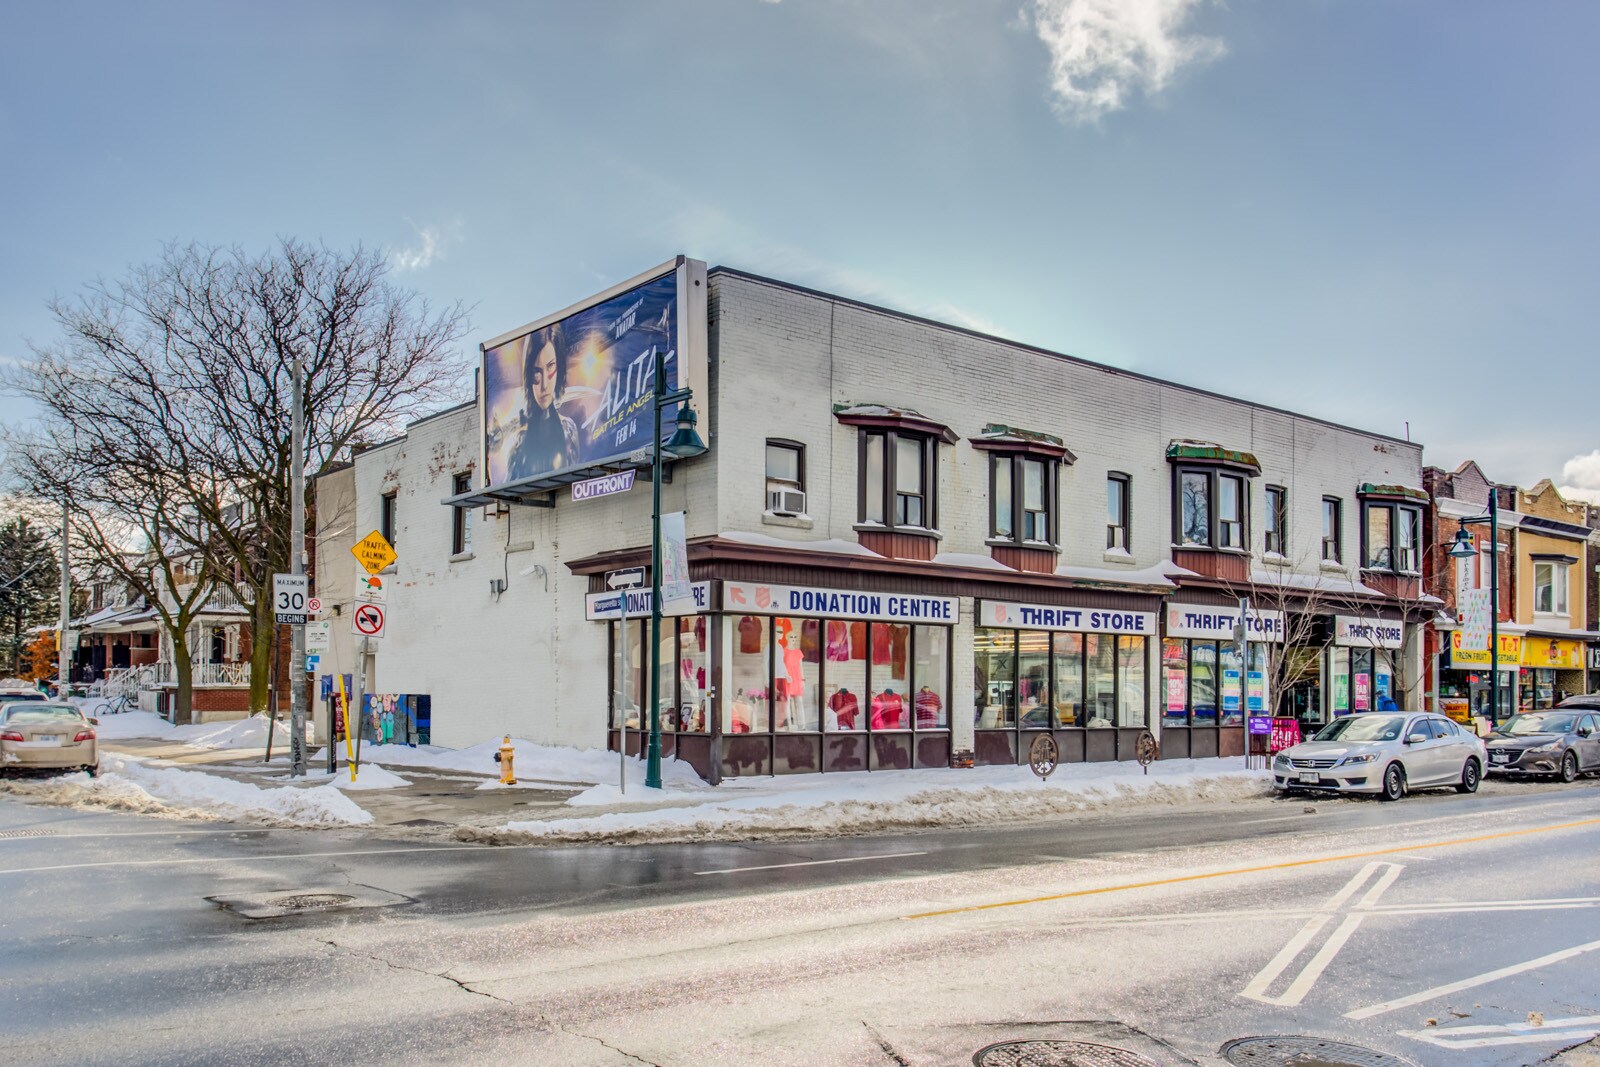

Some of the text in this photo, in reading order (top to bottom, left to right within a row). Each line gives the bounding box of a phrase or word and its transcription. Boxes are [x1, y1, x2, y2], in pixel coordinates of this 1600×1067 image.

[615, 311, 636, 340] AVATAR
[581, 345, 675, 432] ALITA
[593, 389, 655, 439] BATTLE ANGEL
[615, 424, 629, 447] FEB
[574, 473, 632, 499] OUTFRONT
[363, 540, 387, 551] TRAFFIC
[361, 550, 387, 561] CALMING
[365, 561, 380, 571] ZONE
[276, 579, 305, 587] MAXIMUM
[278, 592, 304, 610] 30
[789, 590, 951, 619] DONATION CENTRE
[277, 614, 305, 623] BEGINS
[1020, 607, 1144, 631] THRIFT STORE
[1185, 613, 1282, 633] THRIFT TORE
[1349, 625, 1401, 640] THRIFT STORE
[1473, 652, 1487, 661] FRUIT
